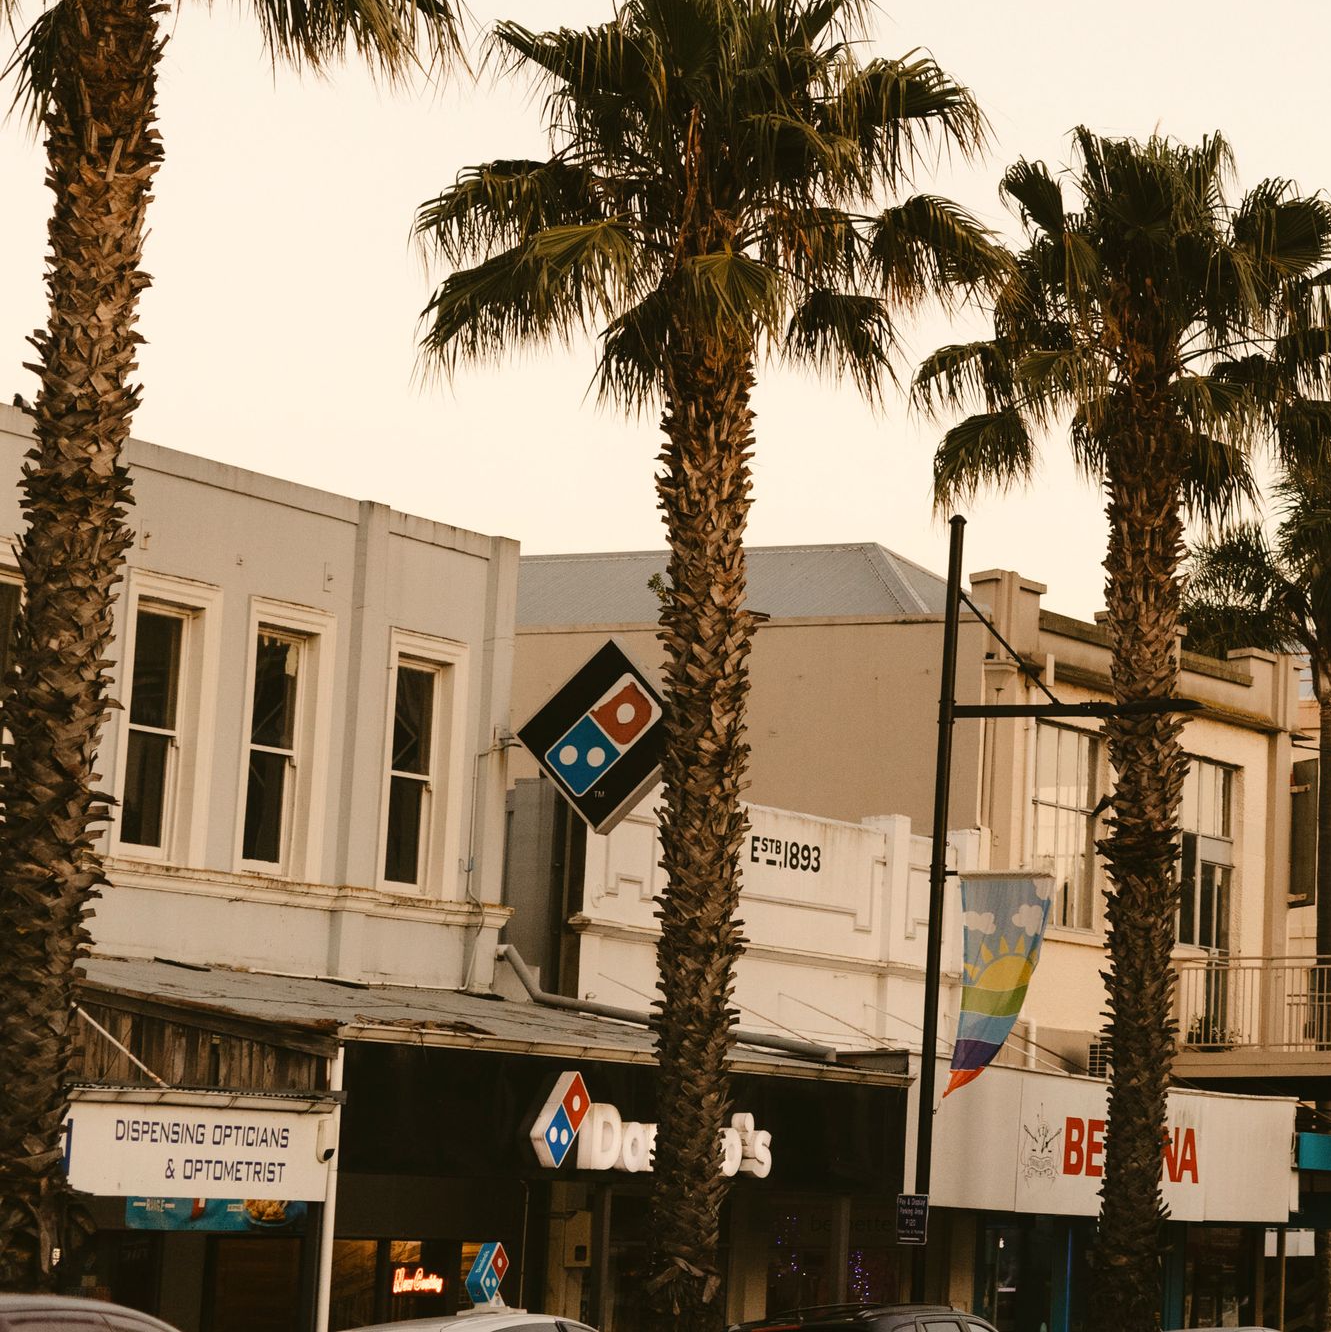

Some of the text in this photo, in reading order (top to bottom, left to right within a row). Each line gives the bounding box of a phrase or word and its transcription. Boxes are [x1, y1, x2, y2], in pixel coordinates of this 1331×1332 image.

[783, 841, 821, 873] 1893
[115, 1119, 290, 1149] DISPENSING OPTICIANS
[577, 1102, 773, 1179] Doo's
[1062, 1116, 1199, 1184] BENA
[165, 1158, 286, 1183] & OPTOMETRIST
